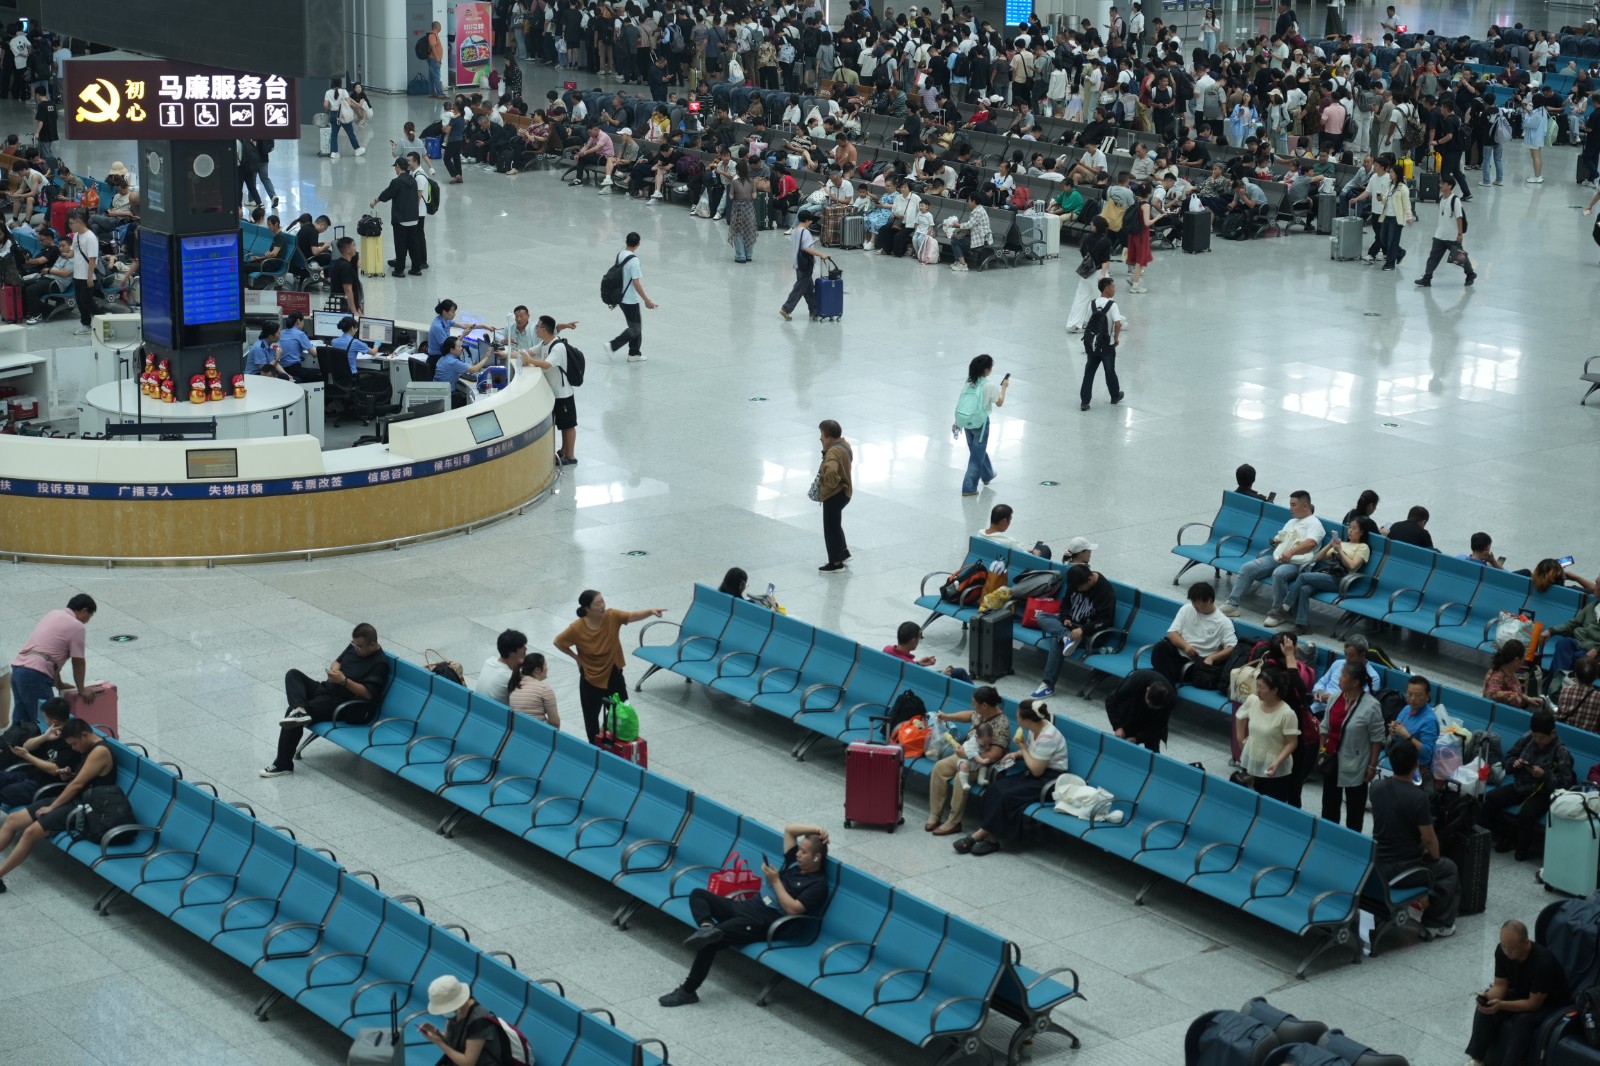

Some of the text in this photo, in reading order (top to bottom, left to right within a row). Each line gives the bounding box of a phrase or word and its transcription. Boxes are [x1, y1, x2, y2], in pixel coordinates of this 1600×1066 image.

[125, 79, 147, 122] 初心
[159, 74, 288, 100] 马廉服务台
[37, 482, 90, 496] 投诉受理
[118, 485, 173, 497] 广播寻人
[208, 483, 264, 496] 失物招领
[291, 476, 343, 491] 车票改签
[367, 466, 413, 483] 信息咨询
[433, 453, 471, 472] 候车引导
